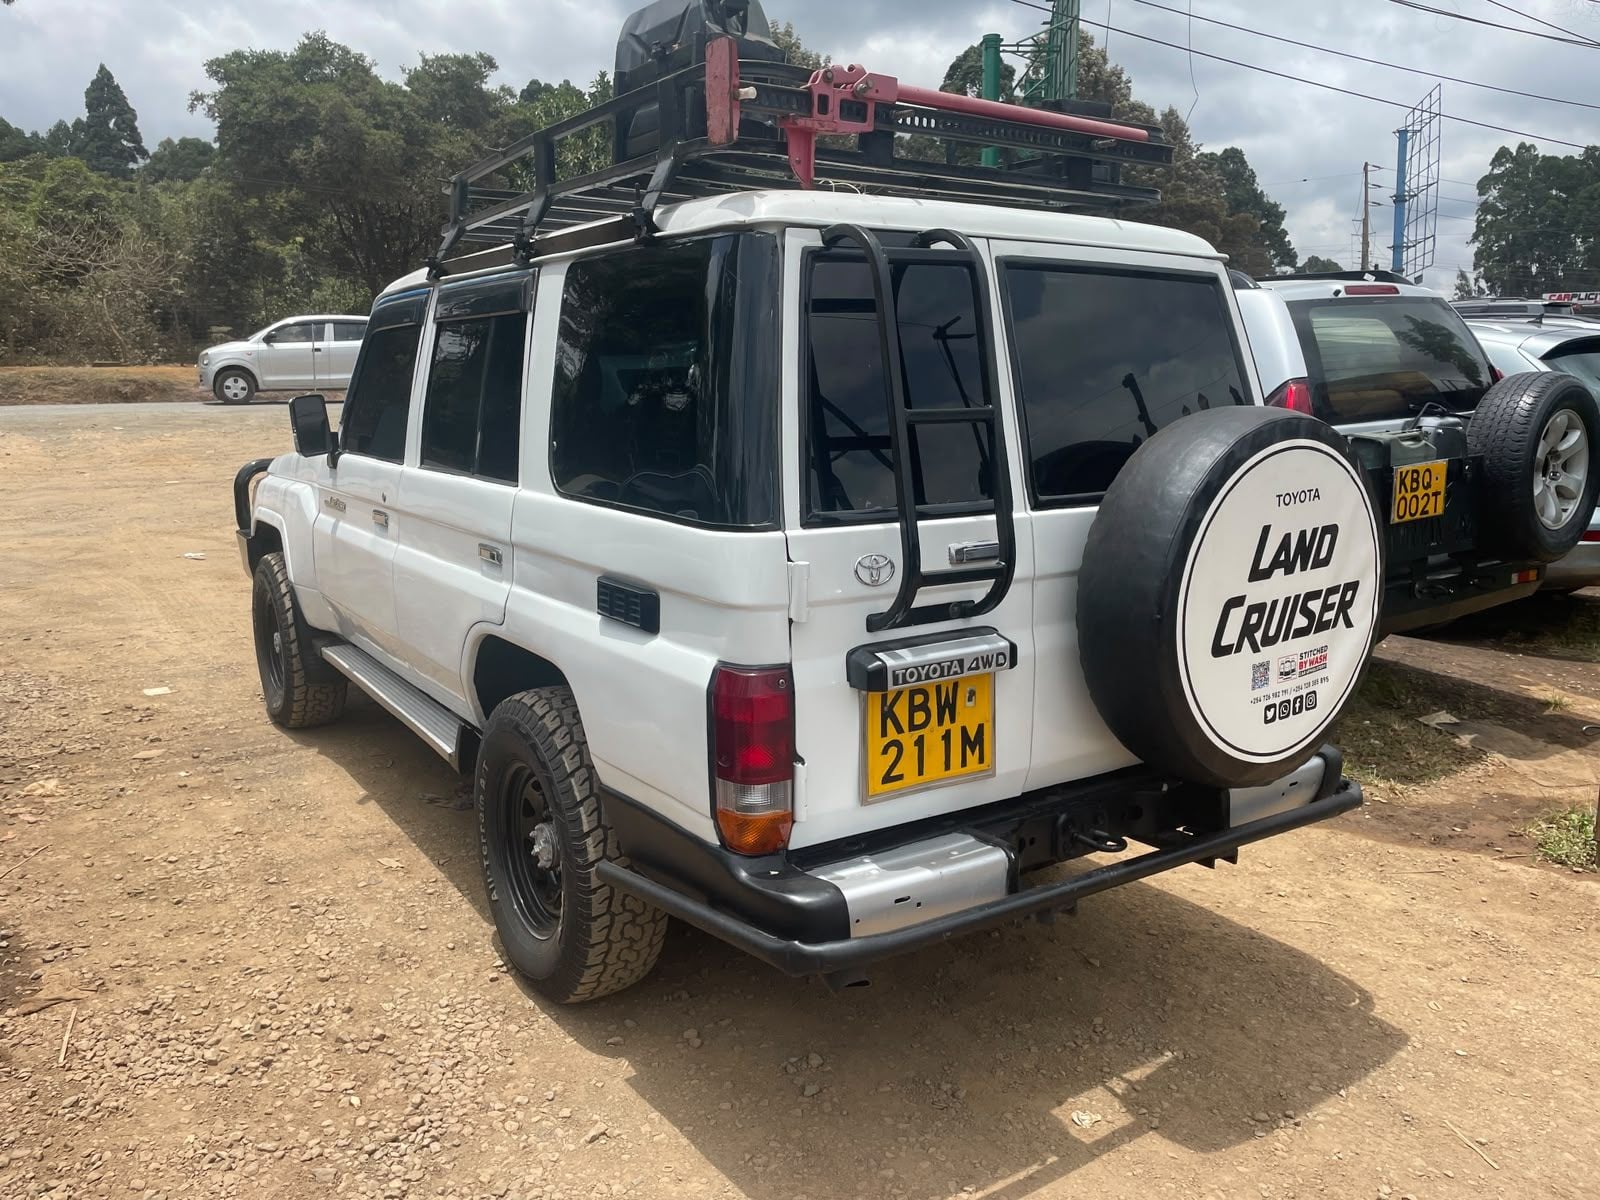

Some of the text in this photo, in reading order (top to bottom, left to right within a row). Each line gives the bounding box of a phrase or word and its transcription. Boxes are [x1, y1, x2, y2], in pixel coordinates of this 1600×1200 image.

[1399, 468, 1432, 494] KBQ
[1276, 488, 1321, 507] TOYOTA
[1397, 491, 1441, 519] 002T
[1247, 523, 1339, 583] LAND
[1211, 580, 1360, 658] CRUISER
[1299, 645, 1328, 660] STITCHED
[1299, 653, 1328, 670] BY WASH
[894, 651, 1008, 686] TOYOTA 4WD
[880, 681, 959, 738] KBW
[880, 723, 985, 785] 211M
